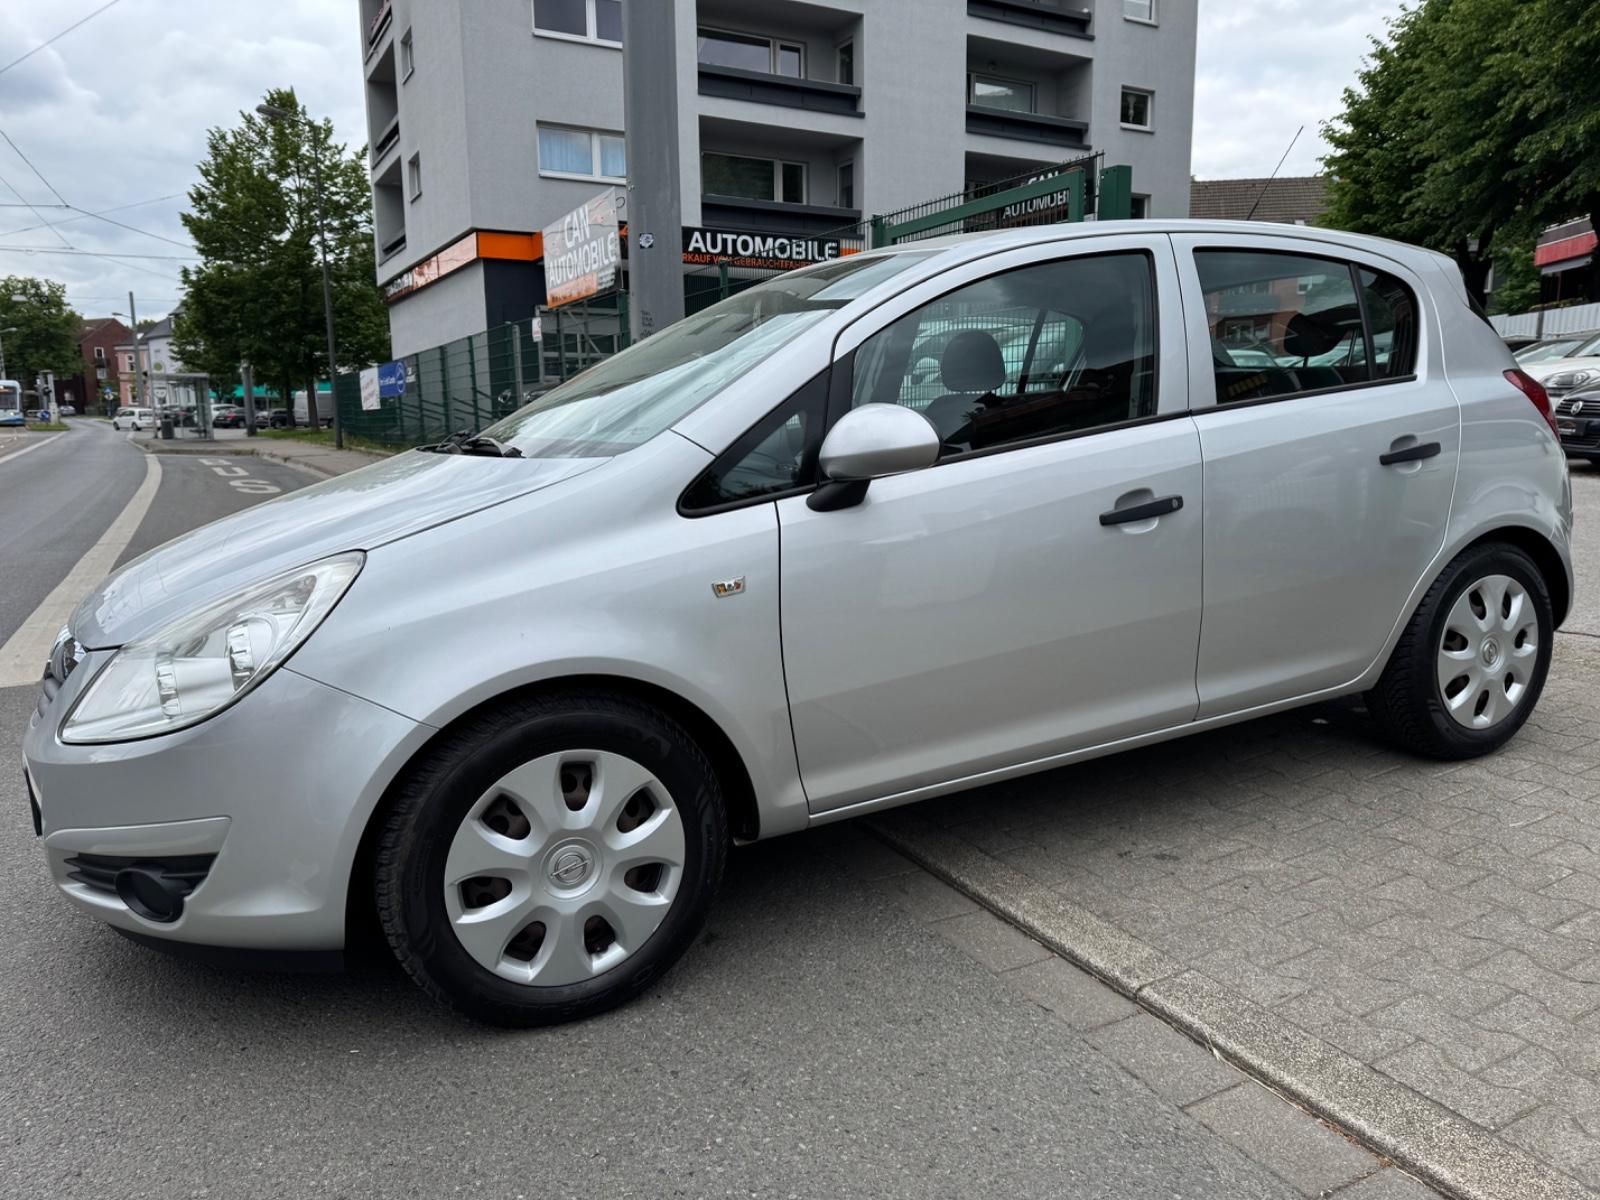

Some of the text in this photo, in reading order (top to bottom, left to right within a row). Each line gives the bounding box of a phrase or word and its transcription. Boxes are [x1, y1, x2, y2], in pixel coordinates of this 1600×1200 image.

[564, 204, 590, 248] CAN
[688, 231, 838, 261] AUTOMOBILE
[549, 231, 617, 288] AUTOMOBILE
